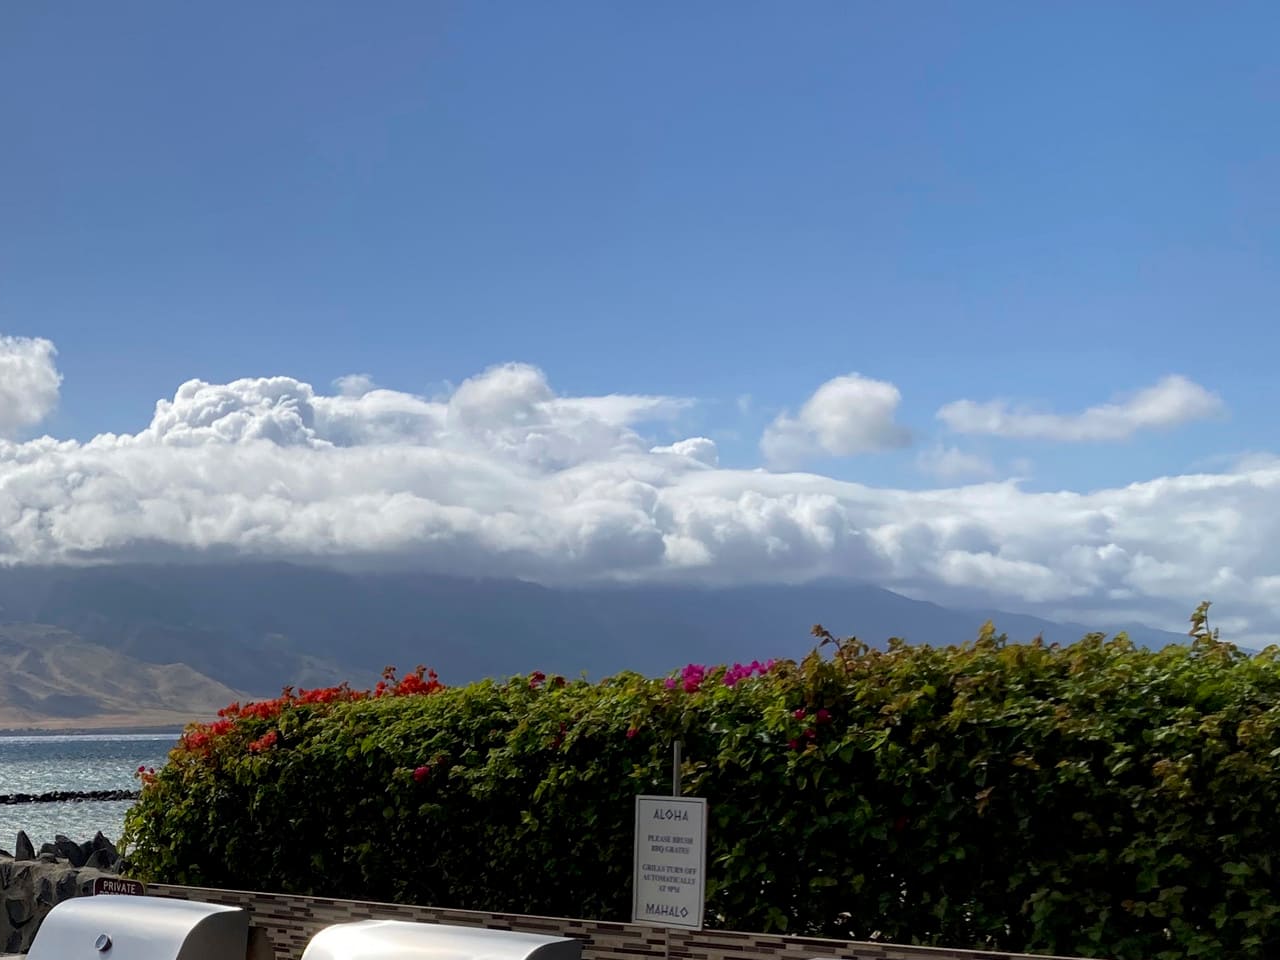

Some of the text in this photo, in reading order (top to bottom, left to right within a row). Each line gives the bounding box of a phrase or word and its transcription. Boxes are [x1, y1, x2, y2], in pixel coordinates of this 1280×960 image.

[653, 809, 689, 821] ALOHA
[647, 834, 671, 843] PLEASE
[666, 866, 683, 874] TURN
[643, 874, 696, 885] AUTOMATICALLY
[103, 880, 136, 894] PRIVATE
[646, 903, 688, 918] MAHALO
